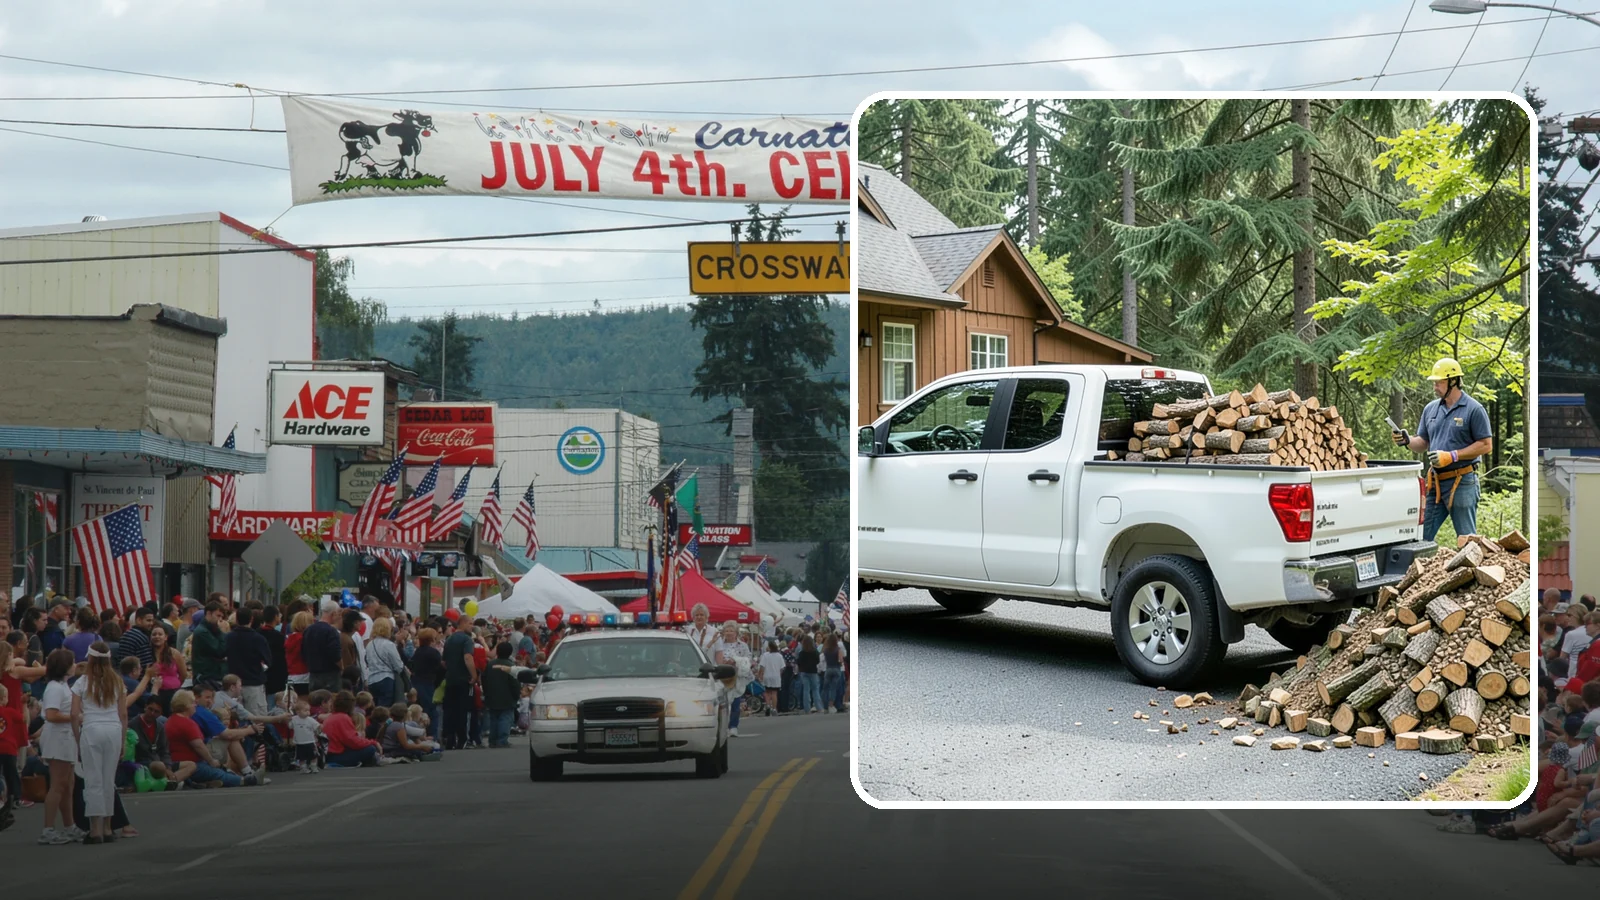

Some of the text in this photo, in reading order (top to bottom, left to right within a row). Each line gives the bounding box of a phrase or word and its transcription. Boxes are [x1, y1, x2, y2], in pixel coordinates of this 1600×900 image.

[481, 141, 605, 193] JULY
[632, 150, 746, 198] 4th.
[697, 254, 850, 280] CROSSWA
[283, 380, 373, 420] ACE
[405, 409, 453, 422] CEDAR
[283, 421, 371, 437] Hardware
[416, 428, 477, 447] Coca-Cola
[353, 467, 386, 481] Simpl
[96, 485, 124, 495] Vincent
[126, 486, 136, 494] de
[138, 486, 155, 495] Paul
[688, 526, 741, 535] CRNATION
[699, 535, 730, 543] GLASS
